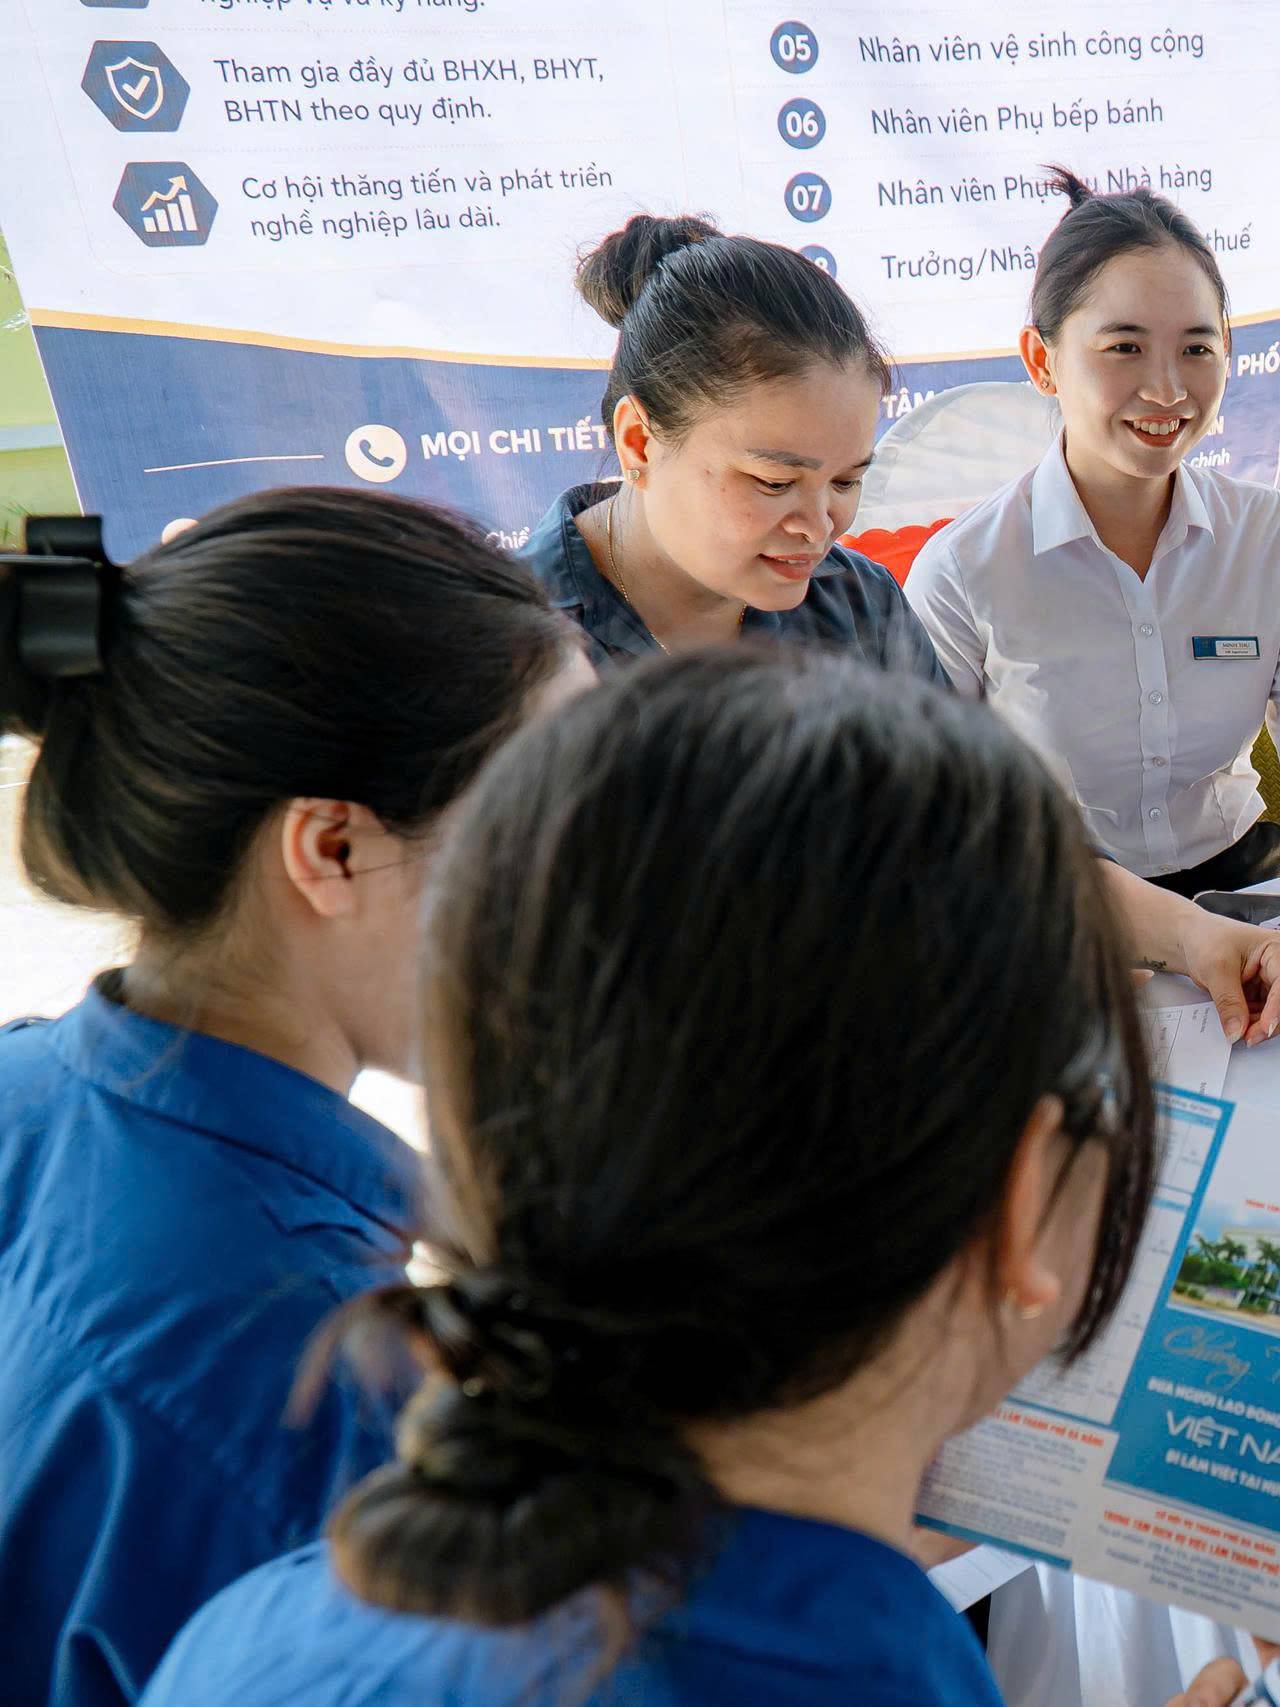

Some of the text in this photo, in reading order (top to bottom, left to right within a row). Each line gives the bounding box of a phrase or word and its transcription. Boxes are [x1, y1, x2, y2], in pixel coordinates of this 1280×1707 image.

[778, 34, 812, 63] 05
[858, 28, 1206, 65] Nhân viên vệ sinh công cộng
[213, 56, 604, 88] Tham gia đầy đủ BHXH, BHYT,
[224, 96, 492, 126] BHTN theo quy định.
[785, 110, 820, 138] 06
[871, 98, 1164, 136] Nhân viên Phụ bếp bánh
[241, 161, 613, 203] Cơ hội thăng tiến và phát triển
[792, 185, 824, 212] 07
[878, 180, 945, 208] Nhân
[951, 178, 996, 205] viên
[1107, 166, 1151, 193] Nhà
[1159, 163, 1212, 191] hàng
[250, 205, 501, 242] nghề nghiệp lâu dài.
[880, 245, 1038, 281] Trưởng/Nhâ
[420, 429, 482, 461] MỌI
[489, 428, 542, 455] CHI
[1237, 341, 1280, 377] PHỐ
[1166, 1409, 1240, 1451] VIỆT
